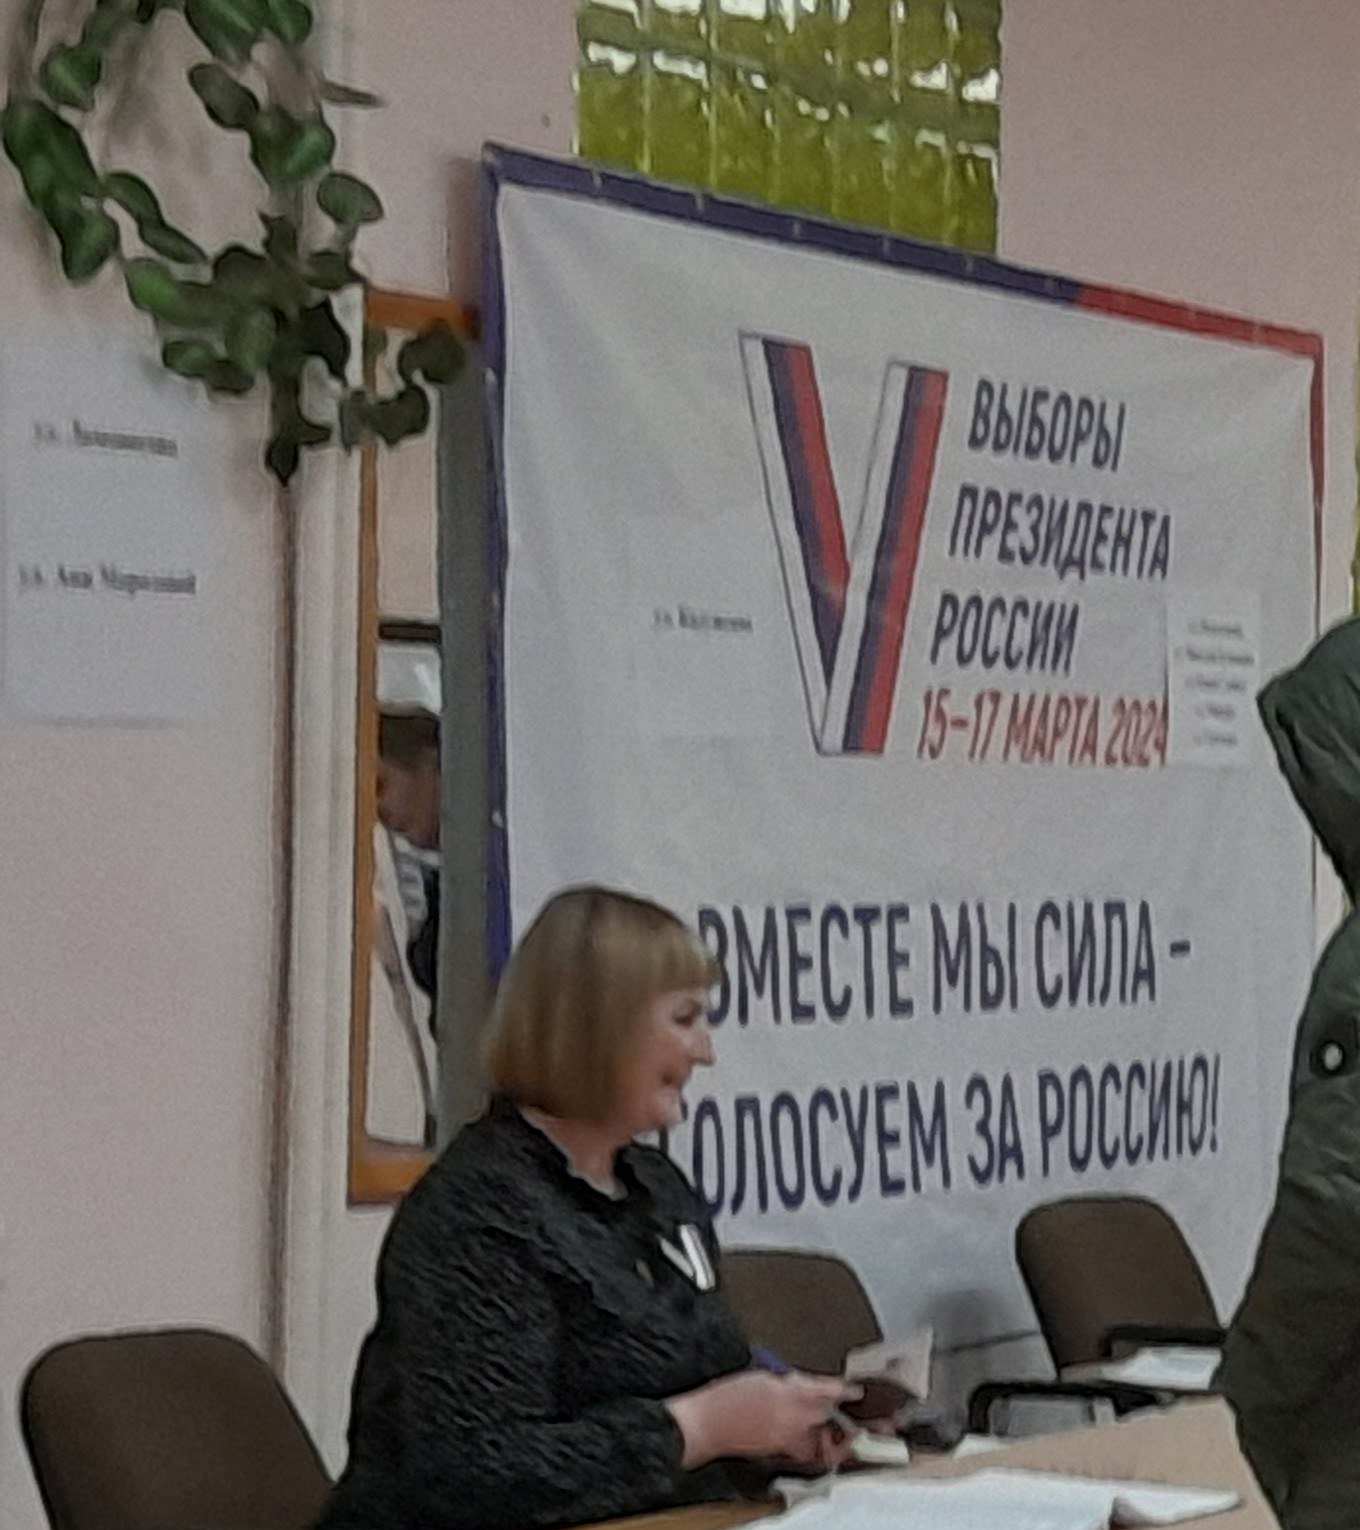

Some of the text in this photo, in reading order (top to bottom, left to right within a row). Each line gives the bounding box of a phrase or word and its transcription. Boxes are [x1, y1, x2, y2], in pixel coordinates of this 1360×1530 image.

[967, 377, 1128, 473] ВЫБОРЫ
[947, 482, 1172, 581] ПРЕЗИДЕНТА
[930, 591, 1079, 677] РОССИИ
[1002, 691, 1100, 765] МАРТА
[1105, 694, 1169, 767] 2024
[930, 900, 1019, 1015] МЫ
[1034, 899, 1157, 1009] СИЛА
[966, 1071, 1025, 1184] ЗА
[1038, 1054, 1221, 1177] РОССИЮ!
